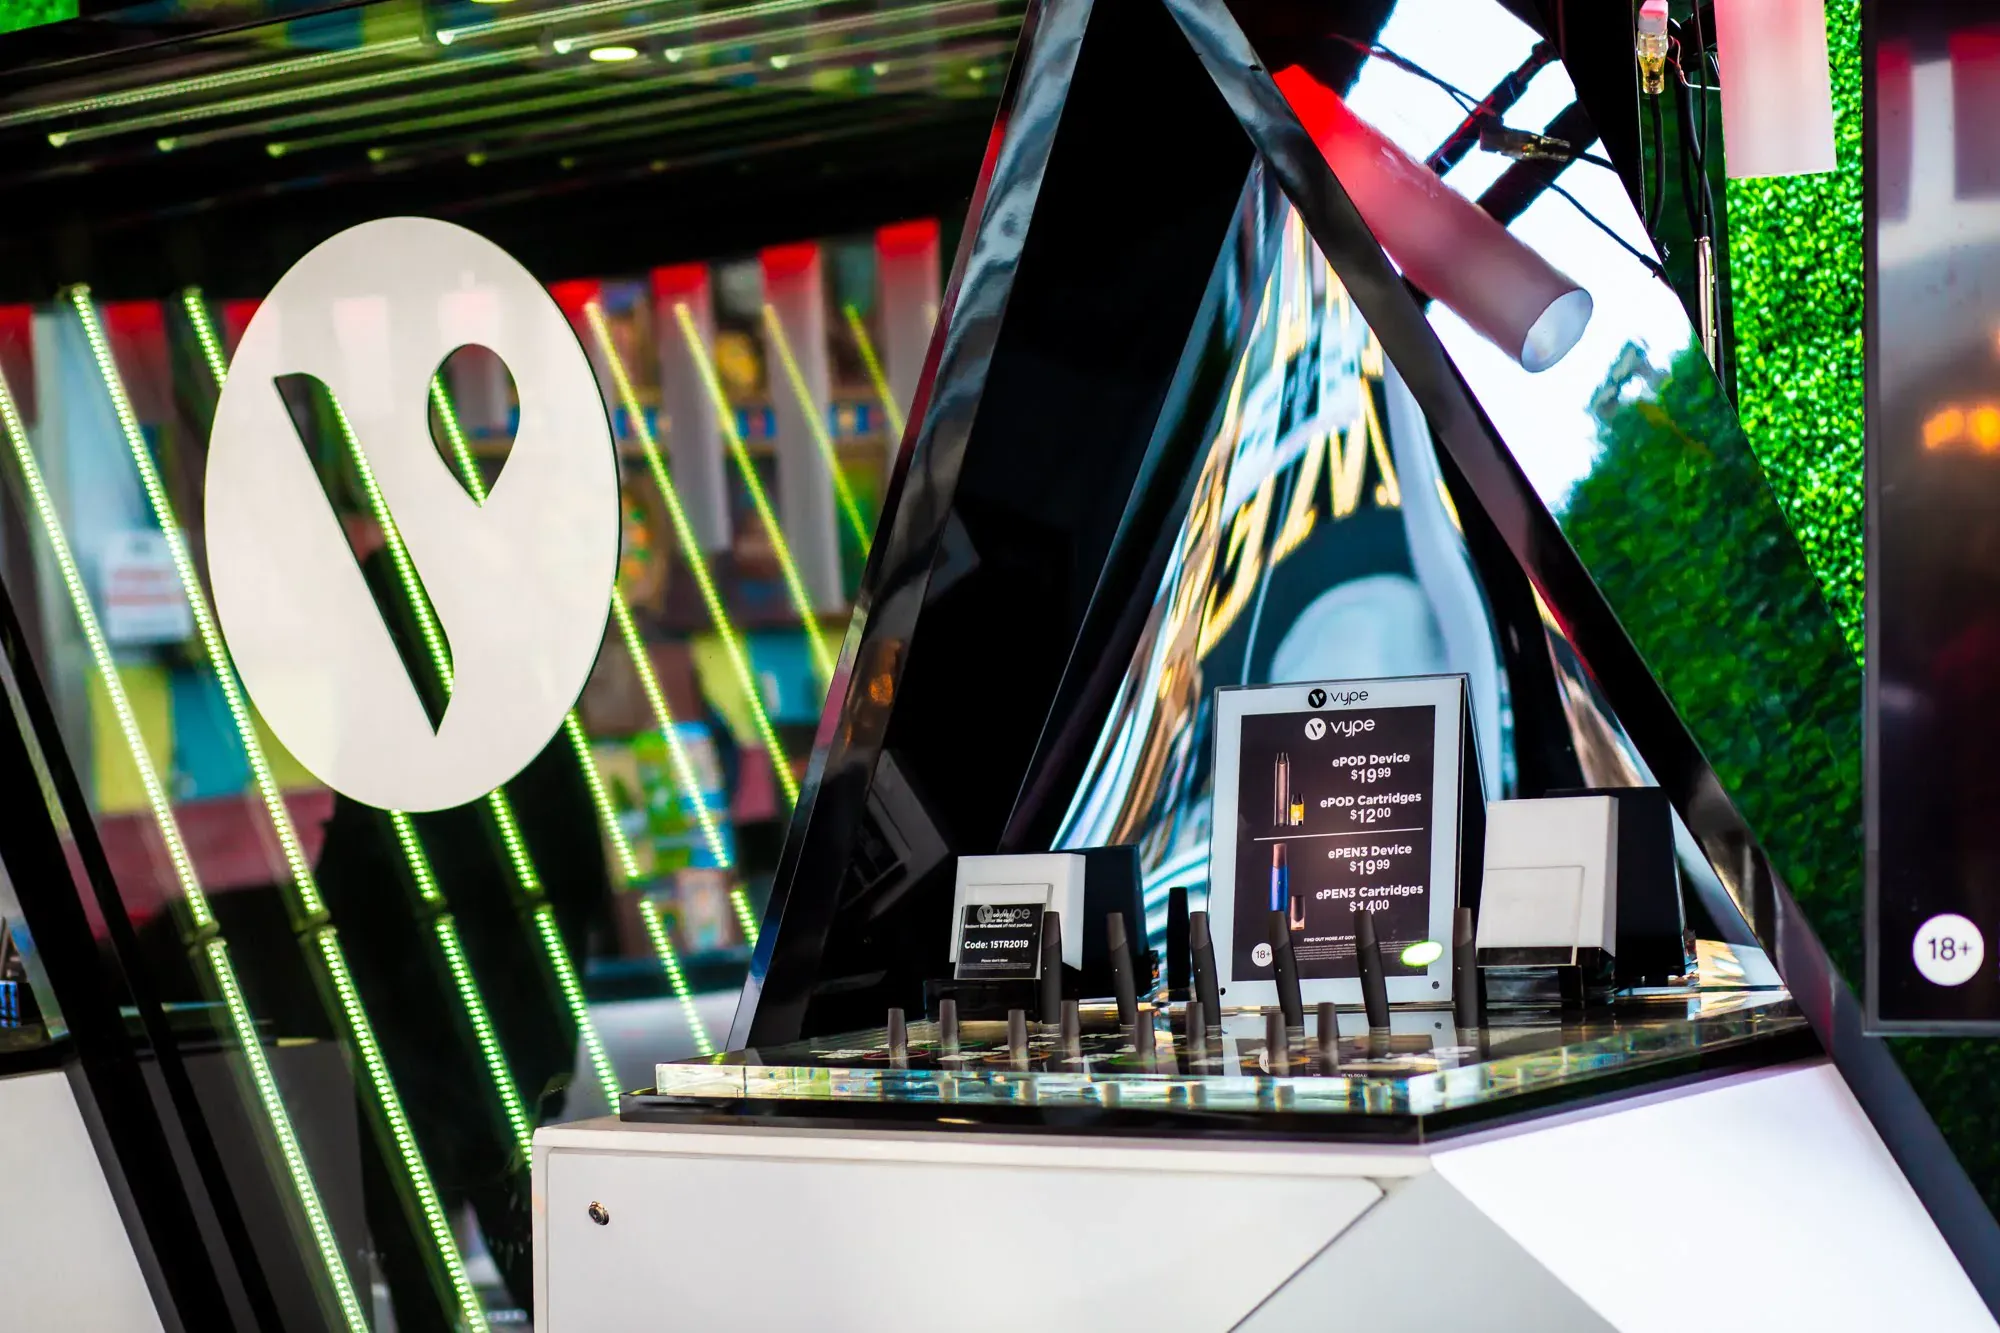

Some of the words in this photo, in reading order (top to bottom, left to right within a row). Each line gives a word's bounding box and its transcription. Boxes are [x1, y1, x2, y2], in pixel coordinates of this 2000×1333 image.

[1330, 690, 1369, 706] vype
[1330, 718, 1375, 737] vype
[1332, 755, 1367, 768] ePOD
[1369, 753, 1411, 765] Device
[1320, 795, 1355, 808] ePOD
[1357, 792, 1422, 807] Cartridges
[1328, 846, 1368, 859] ePEN3
[1371, 844, 1412, 857] Device
[1316, 887, 1356, 900] ePEN3
[1359, 884, 1424, 899] Cartridges
[964, 940, 988, 950] Code:
[990, 940, 1029, 950] 15TR2019
[1928, 936, 1972, 961] 18+
[1256, 950, 1270, 959] 18+
